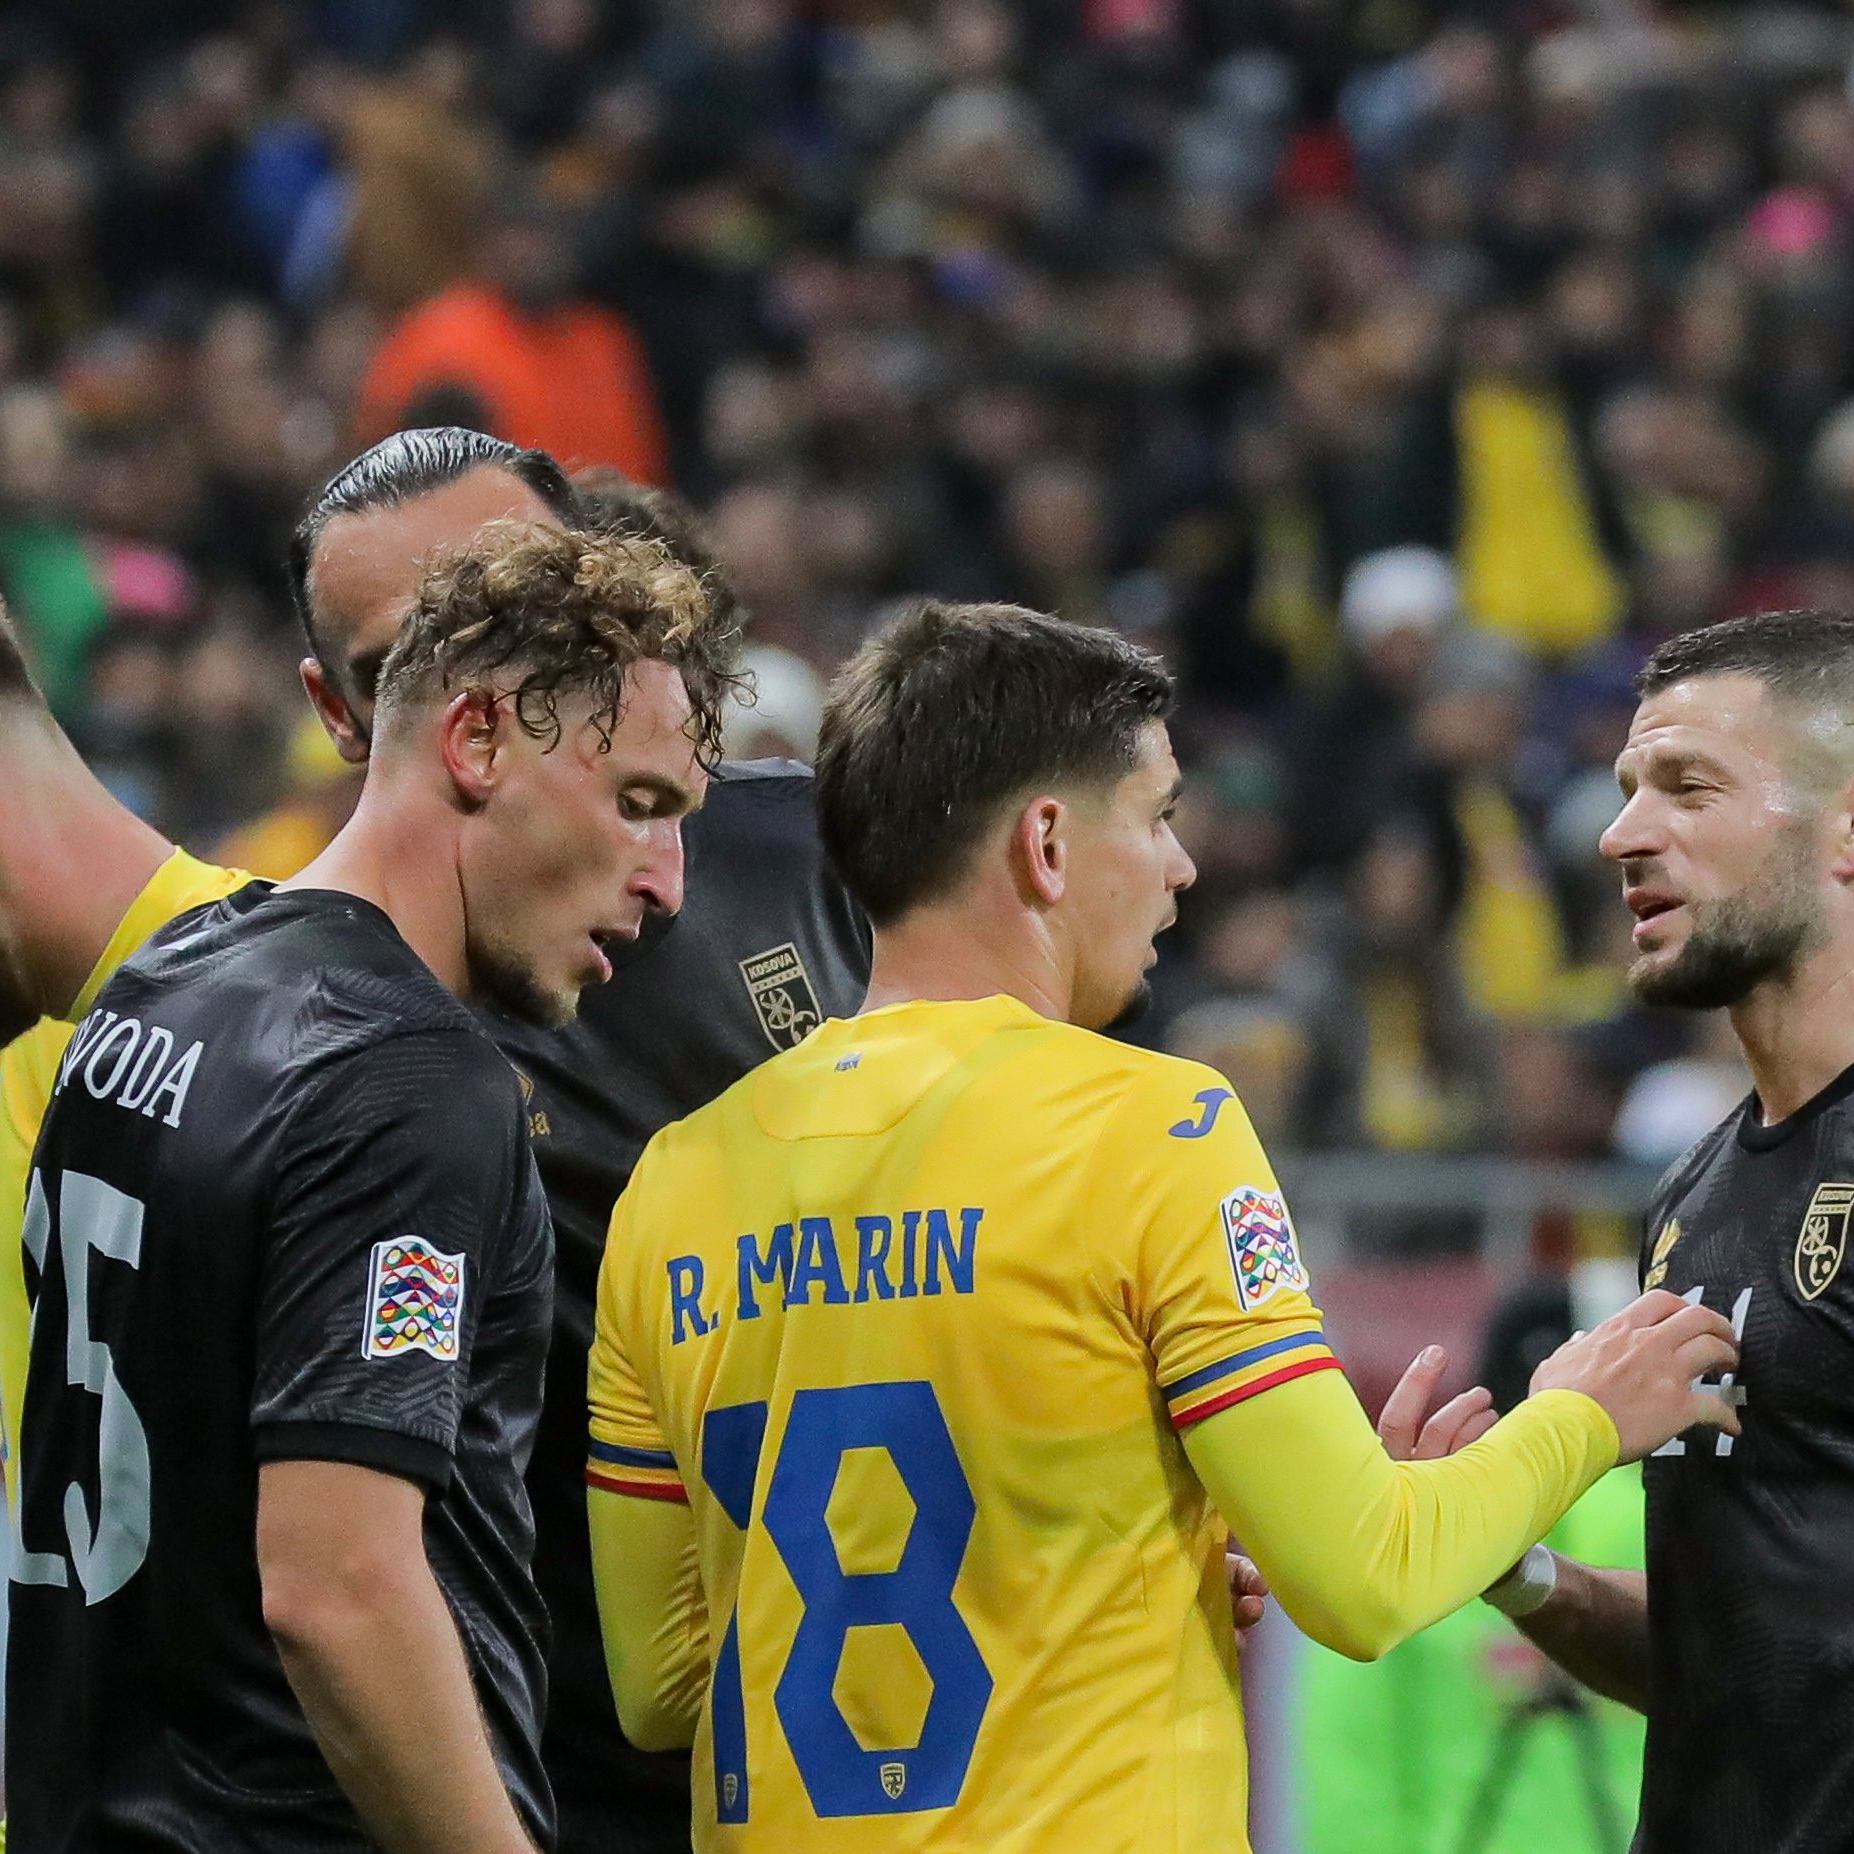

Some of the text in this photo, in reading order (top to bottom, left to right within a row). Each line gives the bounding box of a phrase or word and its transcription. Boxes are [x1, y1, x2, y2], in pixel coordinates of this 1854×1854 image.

[748, 951, 795, 980] KOSOVA
[667, 1207, 984, 1345] R. MARIN
[700, 1380, 995, 1824] 18
